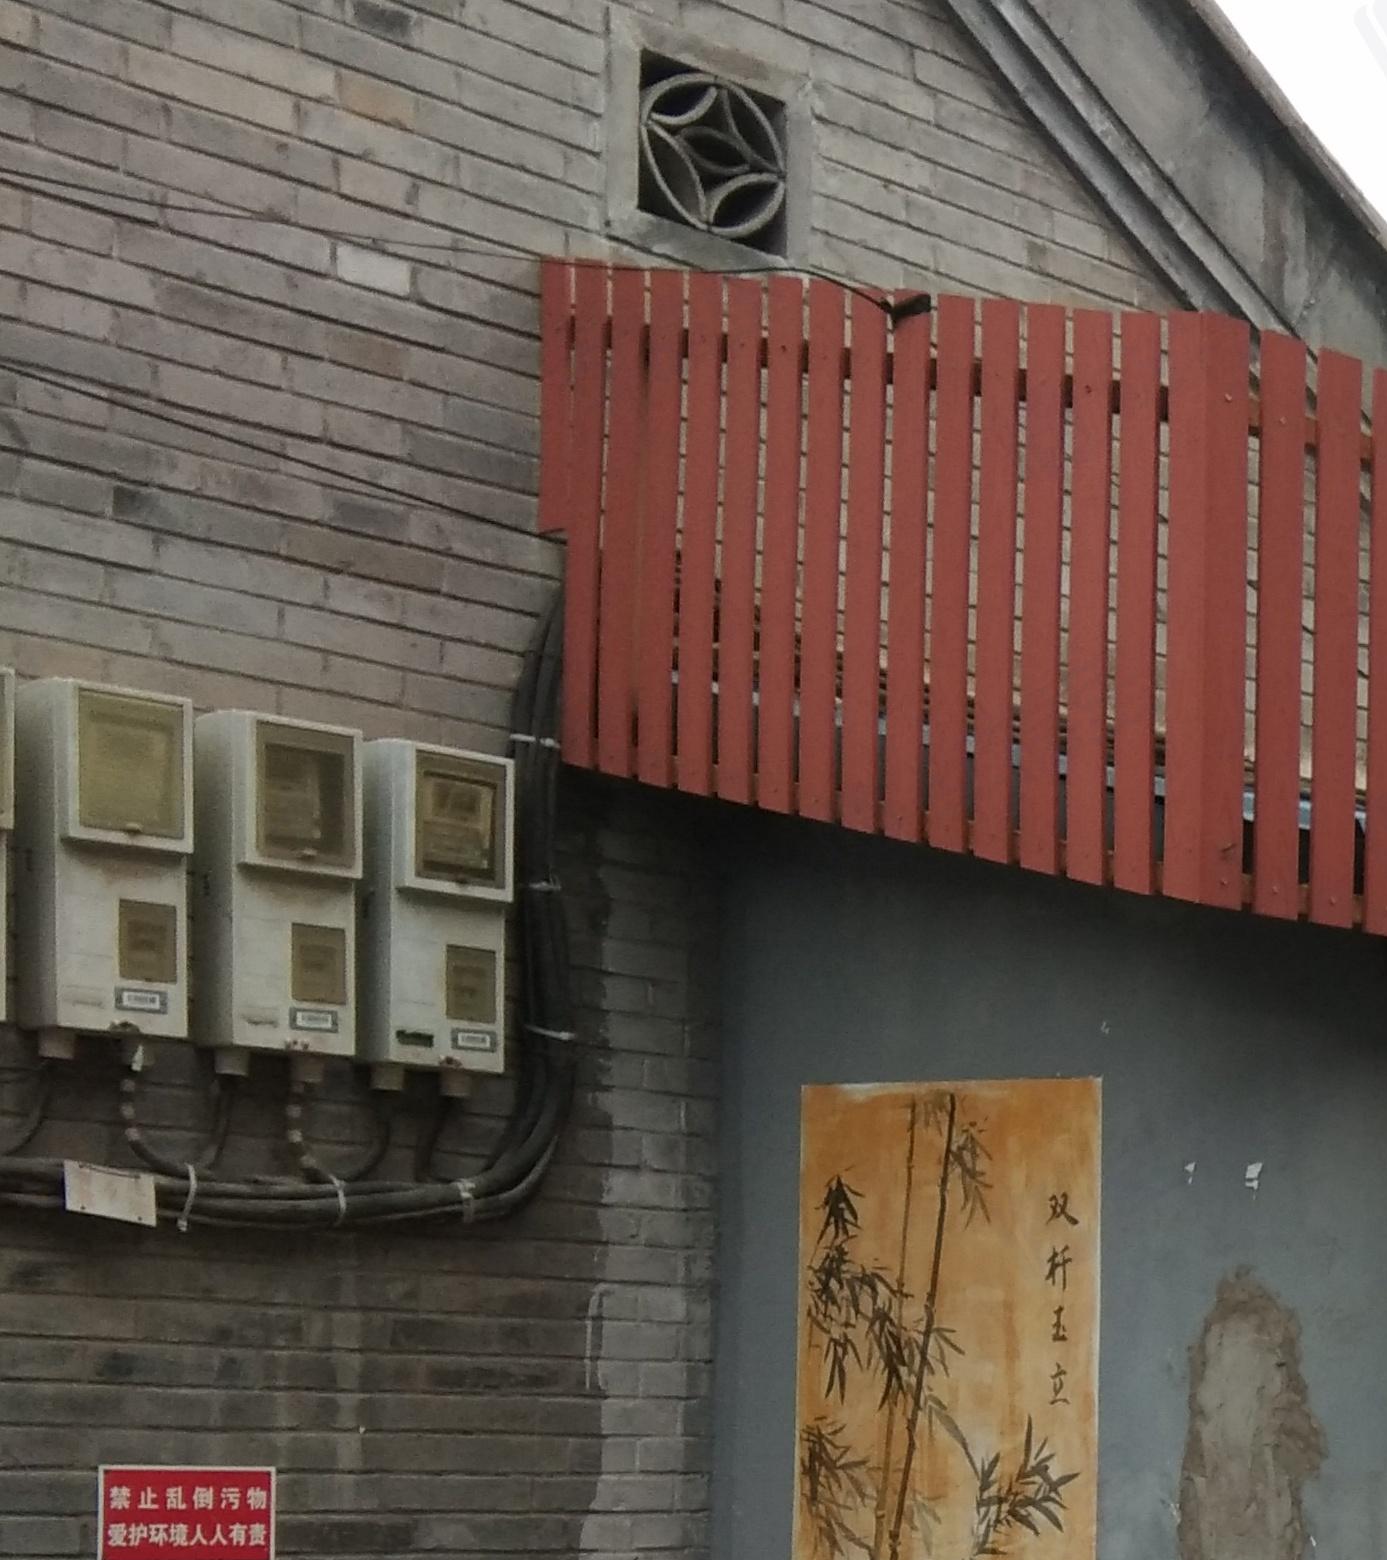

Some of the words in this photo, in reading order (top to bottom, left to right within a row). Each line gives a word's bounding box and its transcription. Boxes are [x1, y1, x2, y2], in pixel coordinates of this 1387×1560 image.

[109, 1486, 267, 1511] 禁止乱倒污物
[108, 1522, 267, 1547] 爱护环境人人有责
